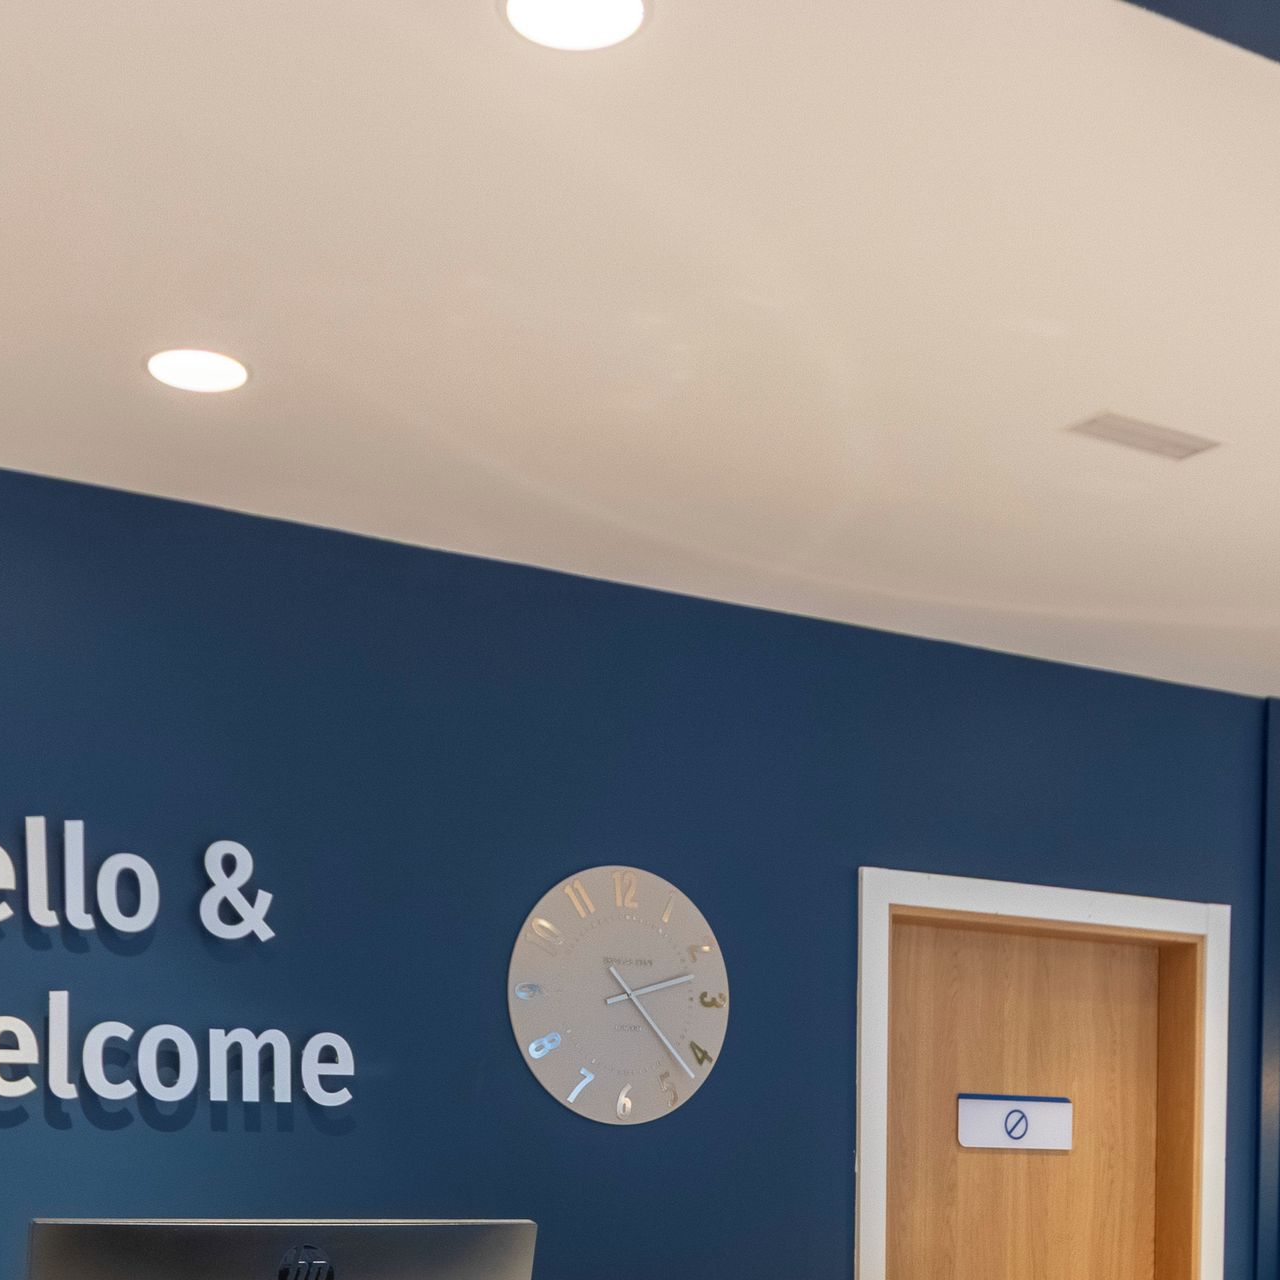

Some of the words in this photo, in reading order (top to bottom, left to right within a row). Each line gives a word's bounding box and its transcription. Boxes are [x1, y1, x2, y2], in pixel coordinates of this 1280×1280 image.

[199, 840, 276, 943] &
[565, 879, 596, 919] 11
[613, 871, 640, 908] 12
[699, 990, 727, 1009] 3
[528, 1031, 562, 1060] 8
[688, 1040, 714, 1066] 4
[566, 1066, 595, 1104] 7
[616, 1083, 634, 1121] 6
[657, 1071, 680, 1108] 5
